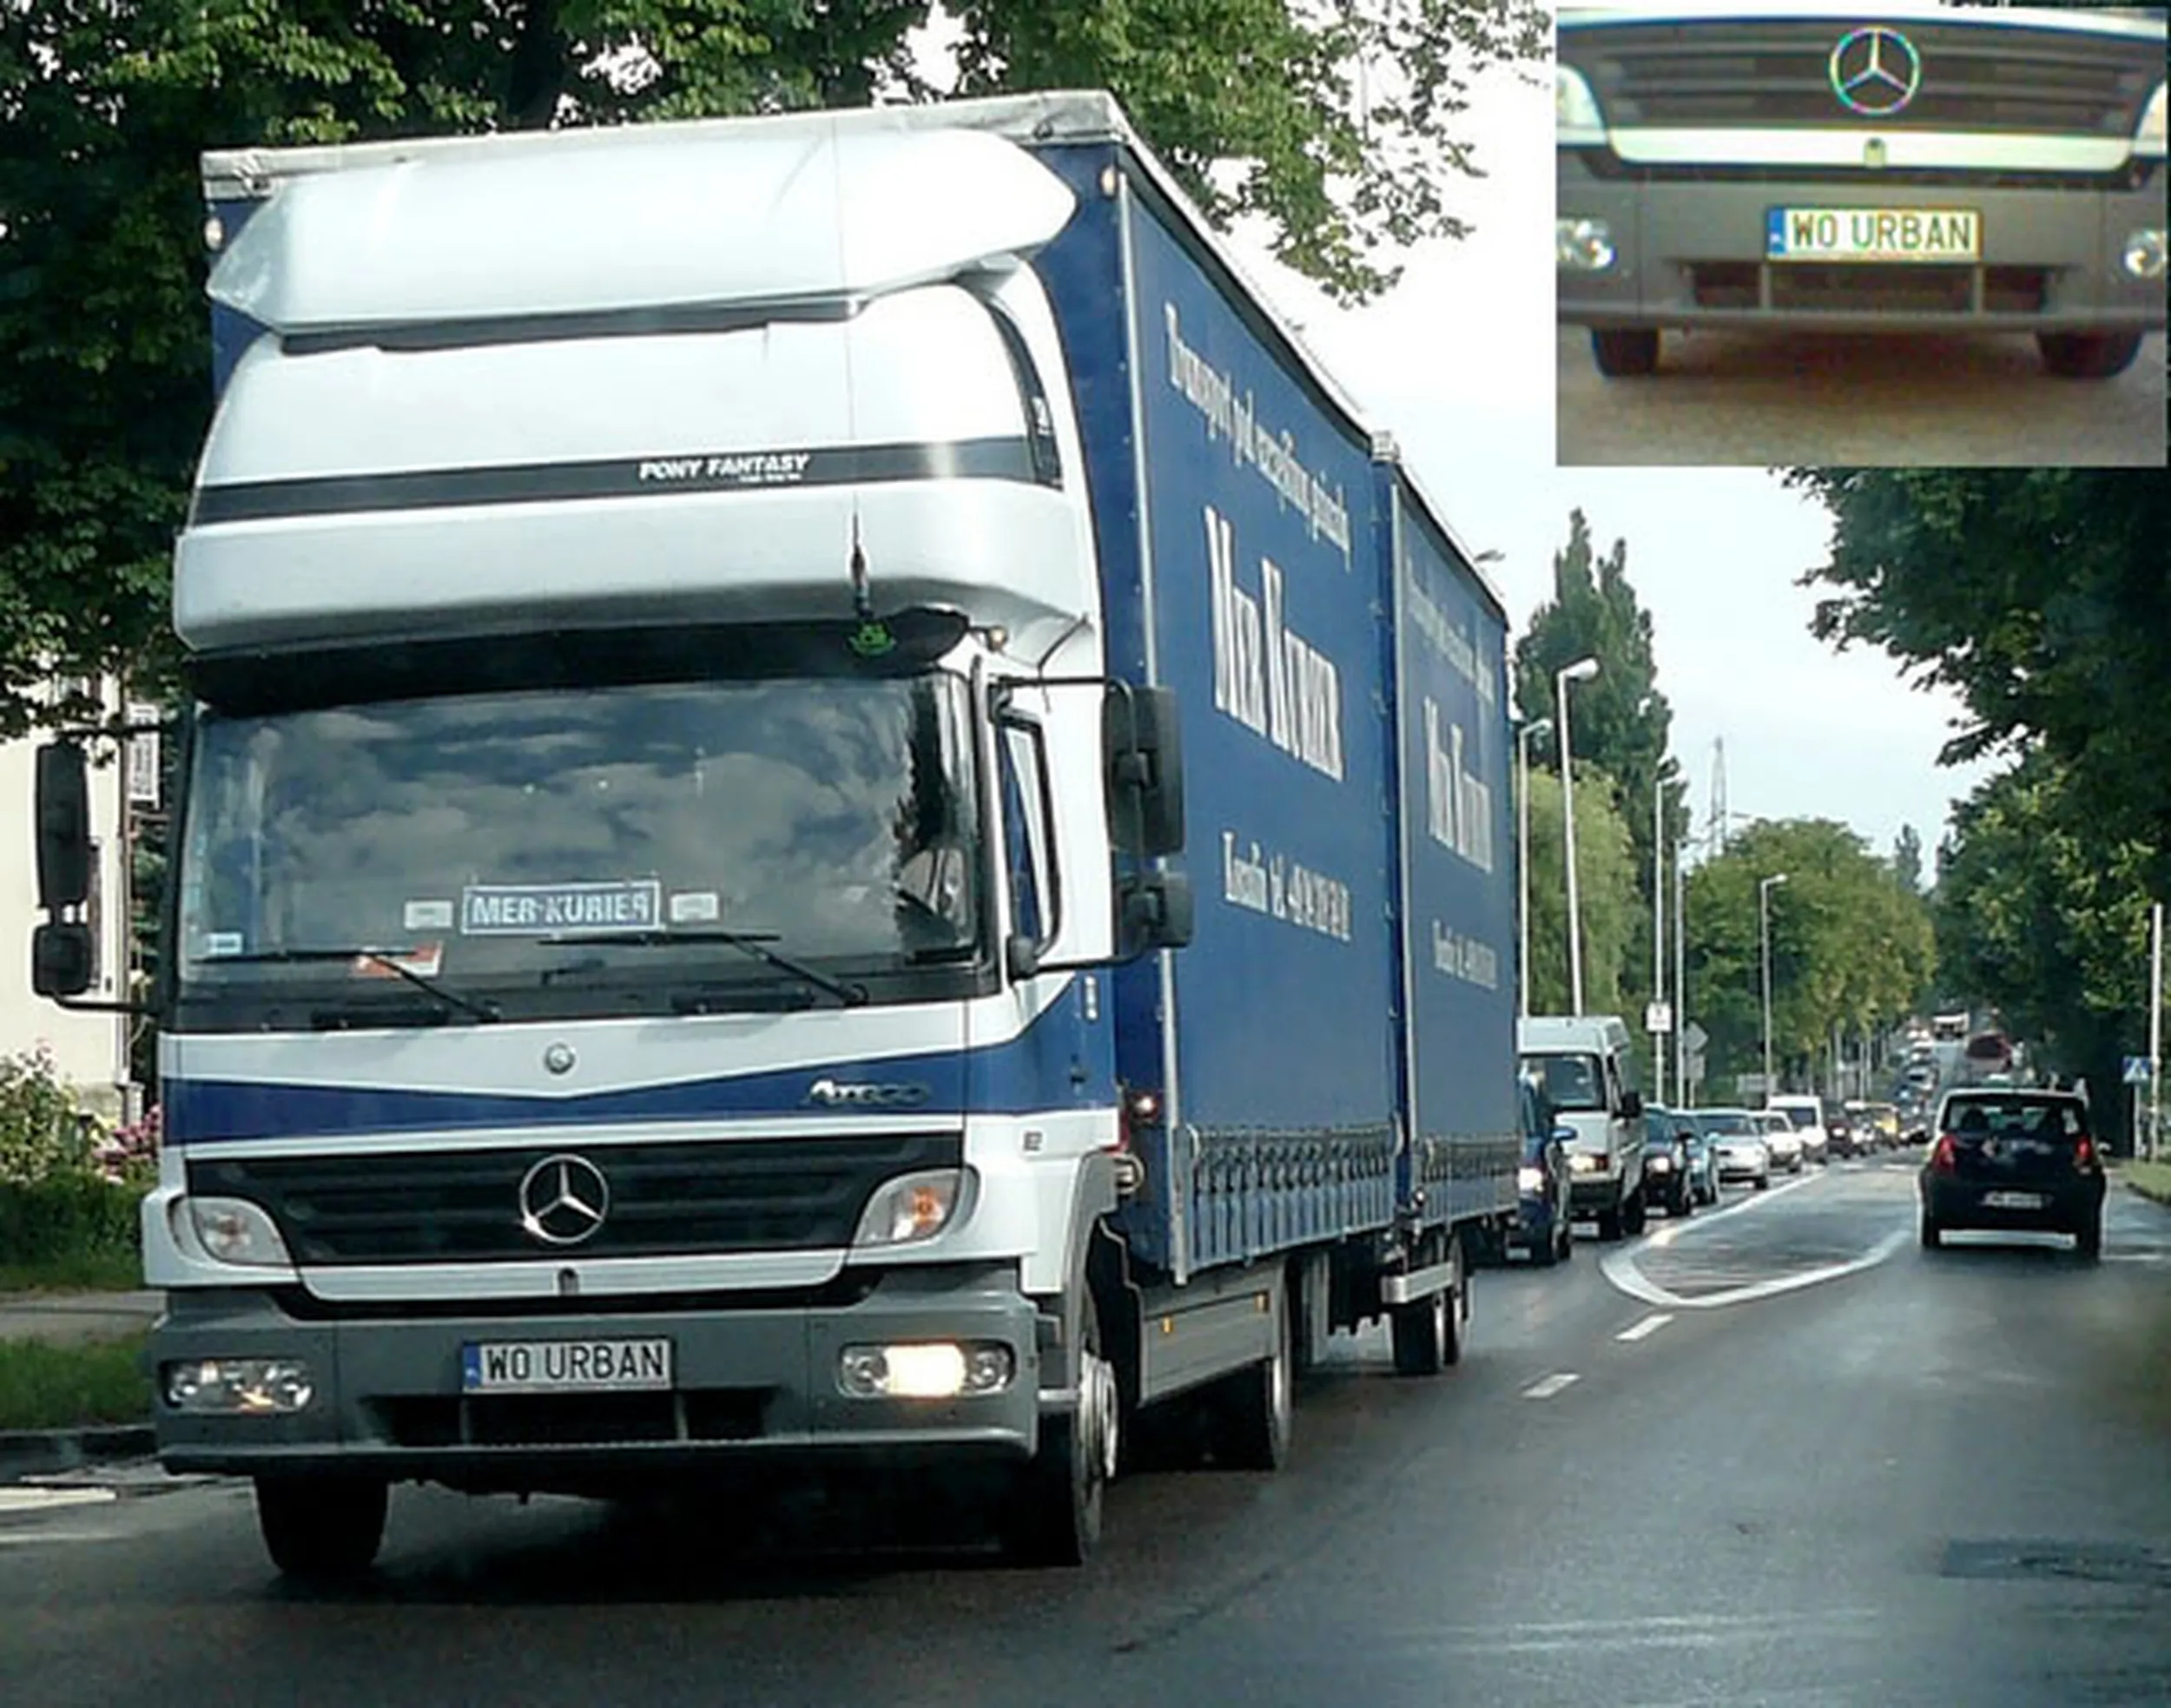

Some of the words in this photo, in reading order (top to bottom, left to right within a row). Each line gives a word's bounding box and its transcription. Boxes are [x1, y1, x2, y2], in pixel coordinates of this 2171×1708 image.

[1792, 213, 1838, 247] WO
[1851, 214, 1970, 250] URBAN
[639, 458, 703, 481] PONY
[707, 452, 810, 478] FANTASY
[486, 1348, 531, 1381] WO
[544, 1344, 663, 1381] URBAN
